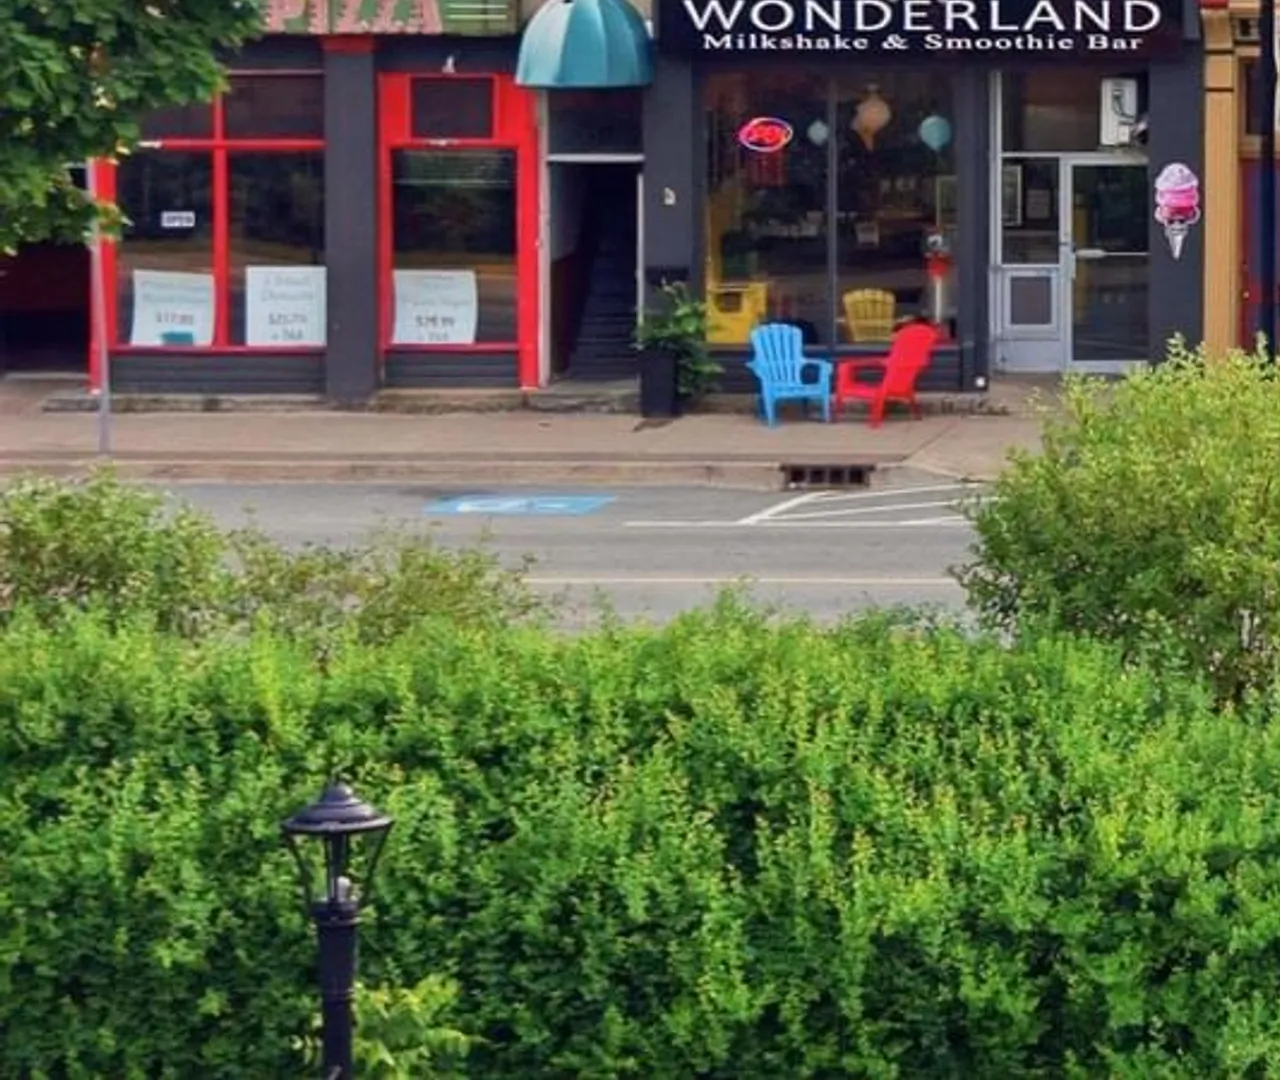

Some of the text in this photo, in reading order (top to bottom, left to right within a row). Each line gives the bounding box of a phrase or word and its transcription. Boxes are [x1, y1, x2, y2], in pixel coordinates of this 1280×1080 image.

[704, 33, 1143, 49] Milkshake & Smoothie Bar
